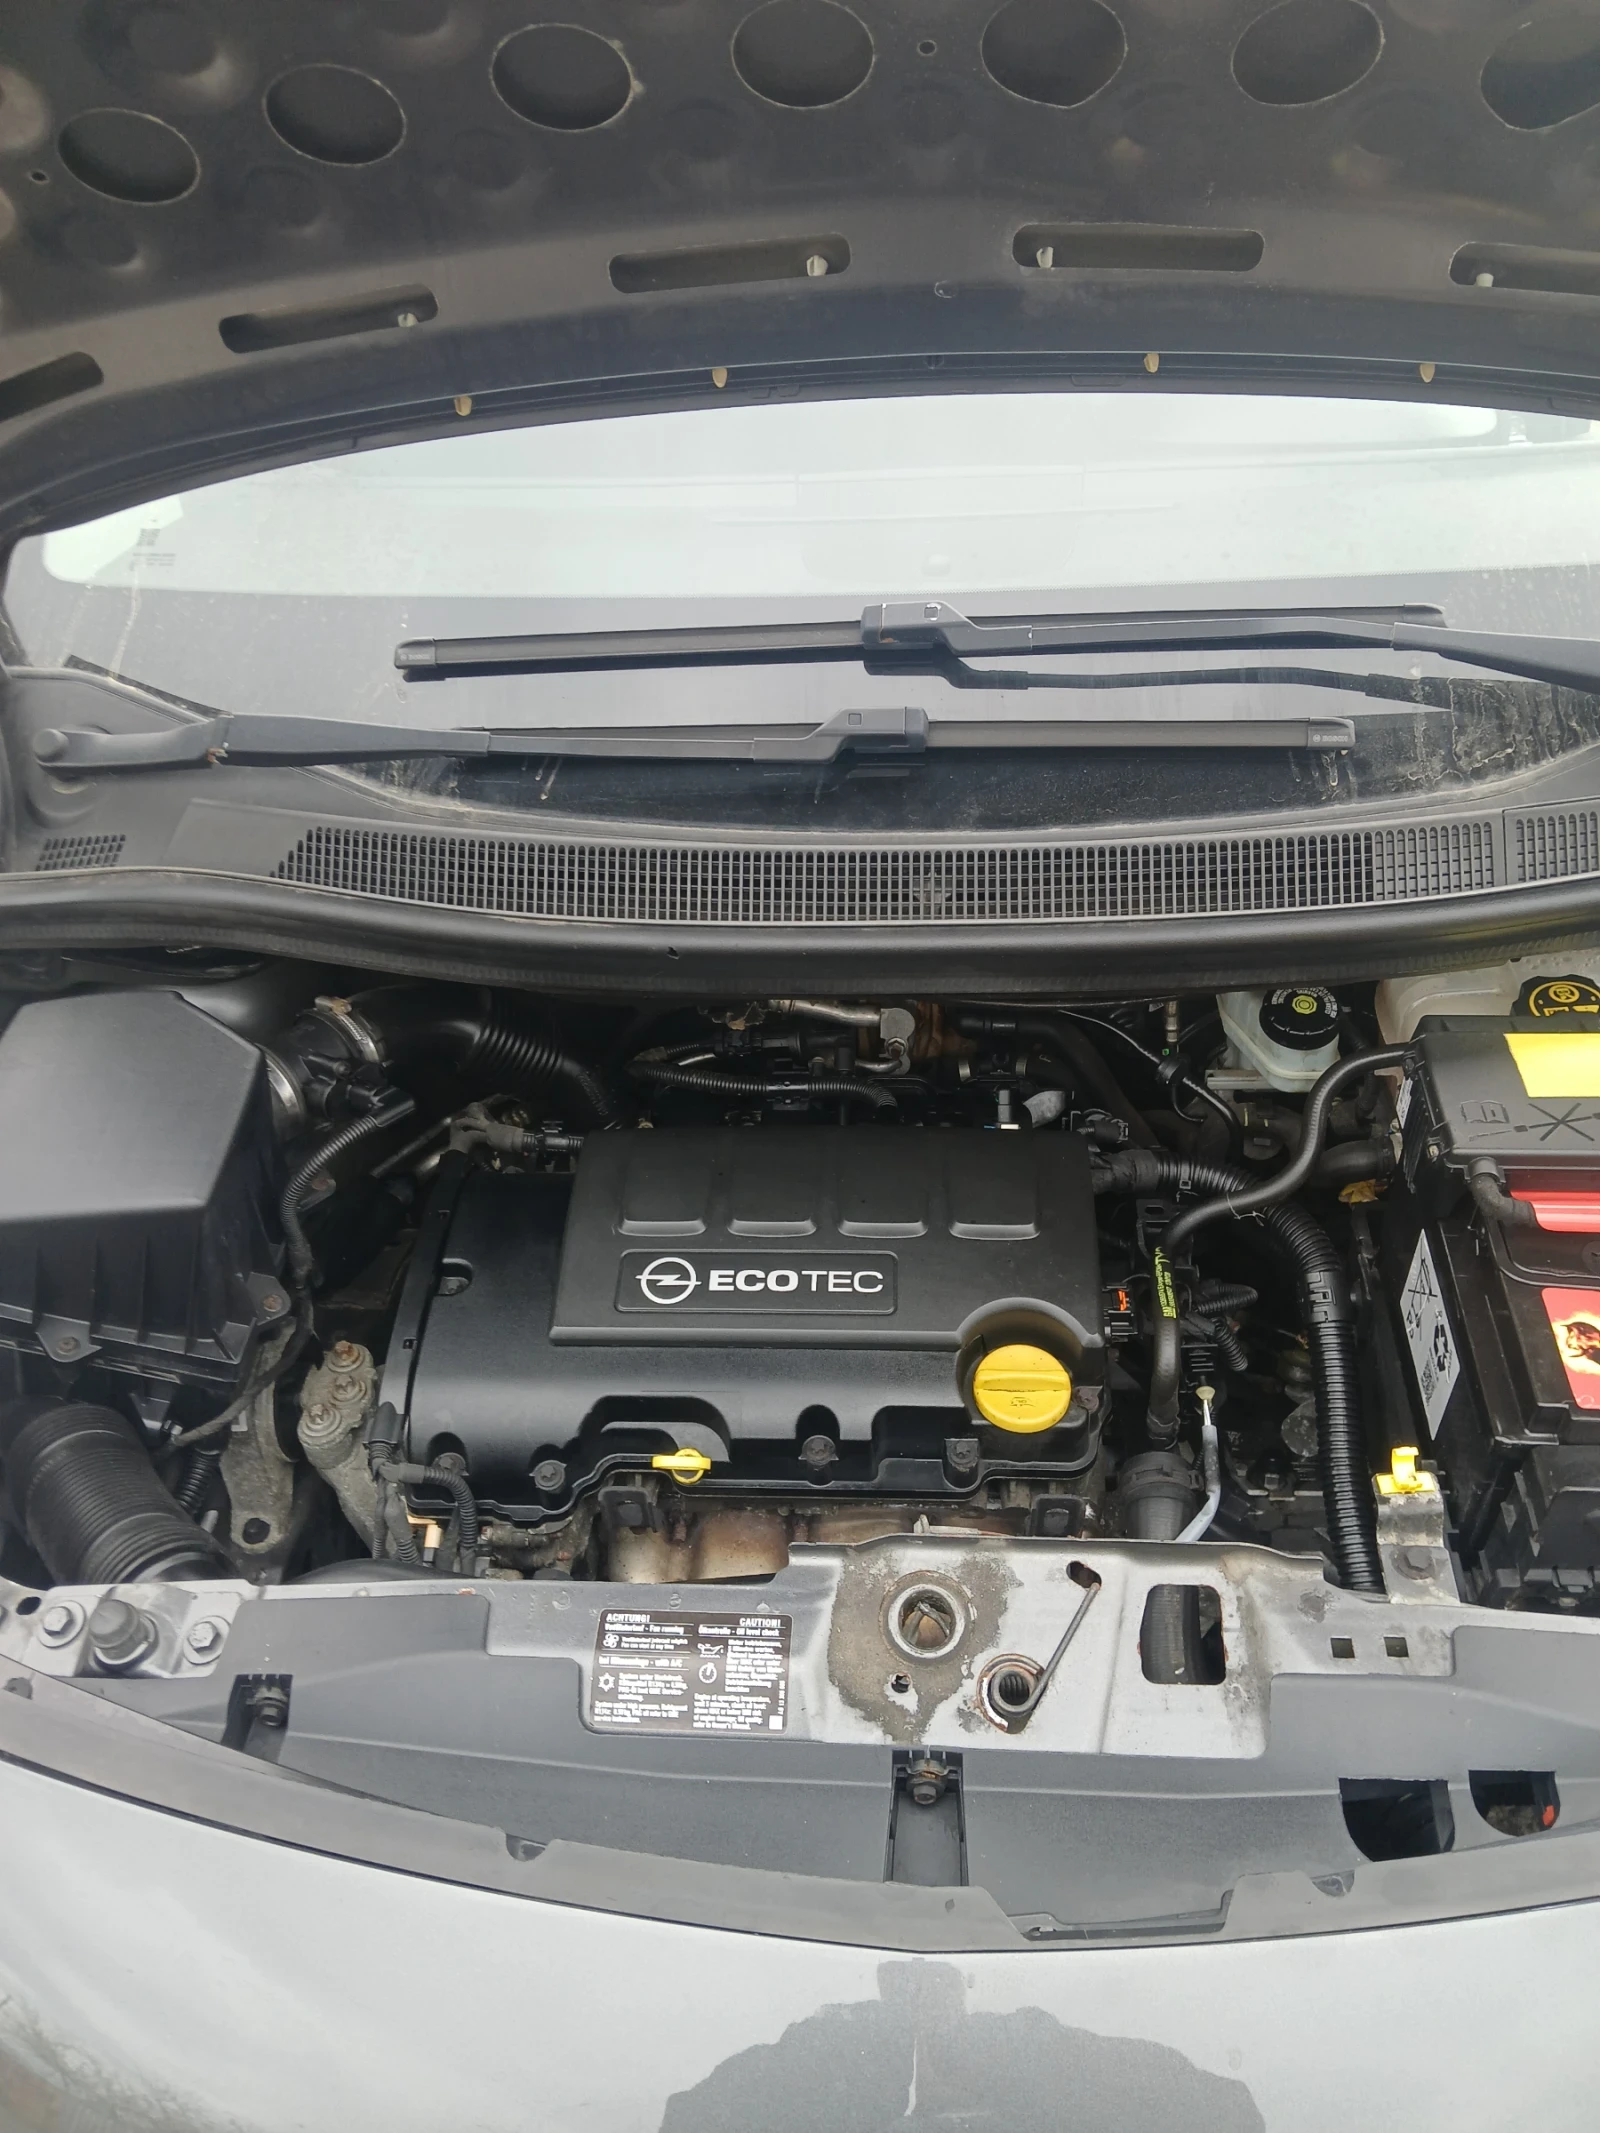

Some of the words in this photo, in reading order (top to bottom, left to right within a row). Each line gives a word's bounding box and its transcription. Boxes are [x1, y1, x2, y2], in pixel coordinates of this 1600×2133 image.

[708, 1269, 884, 1293] ECOTEC
[606, 1613, 650, 1623] ACHTUNG!
[739, 1618, 781, 1627] CAUTION!
